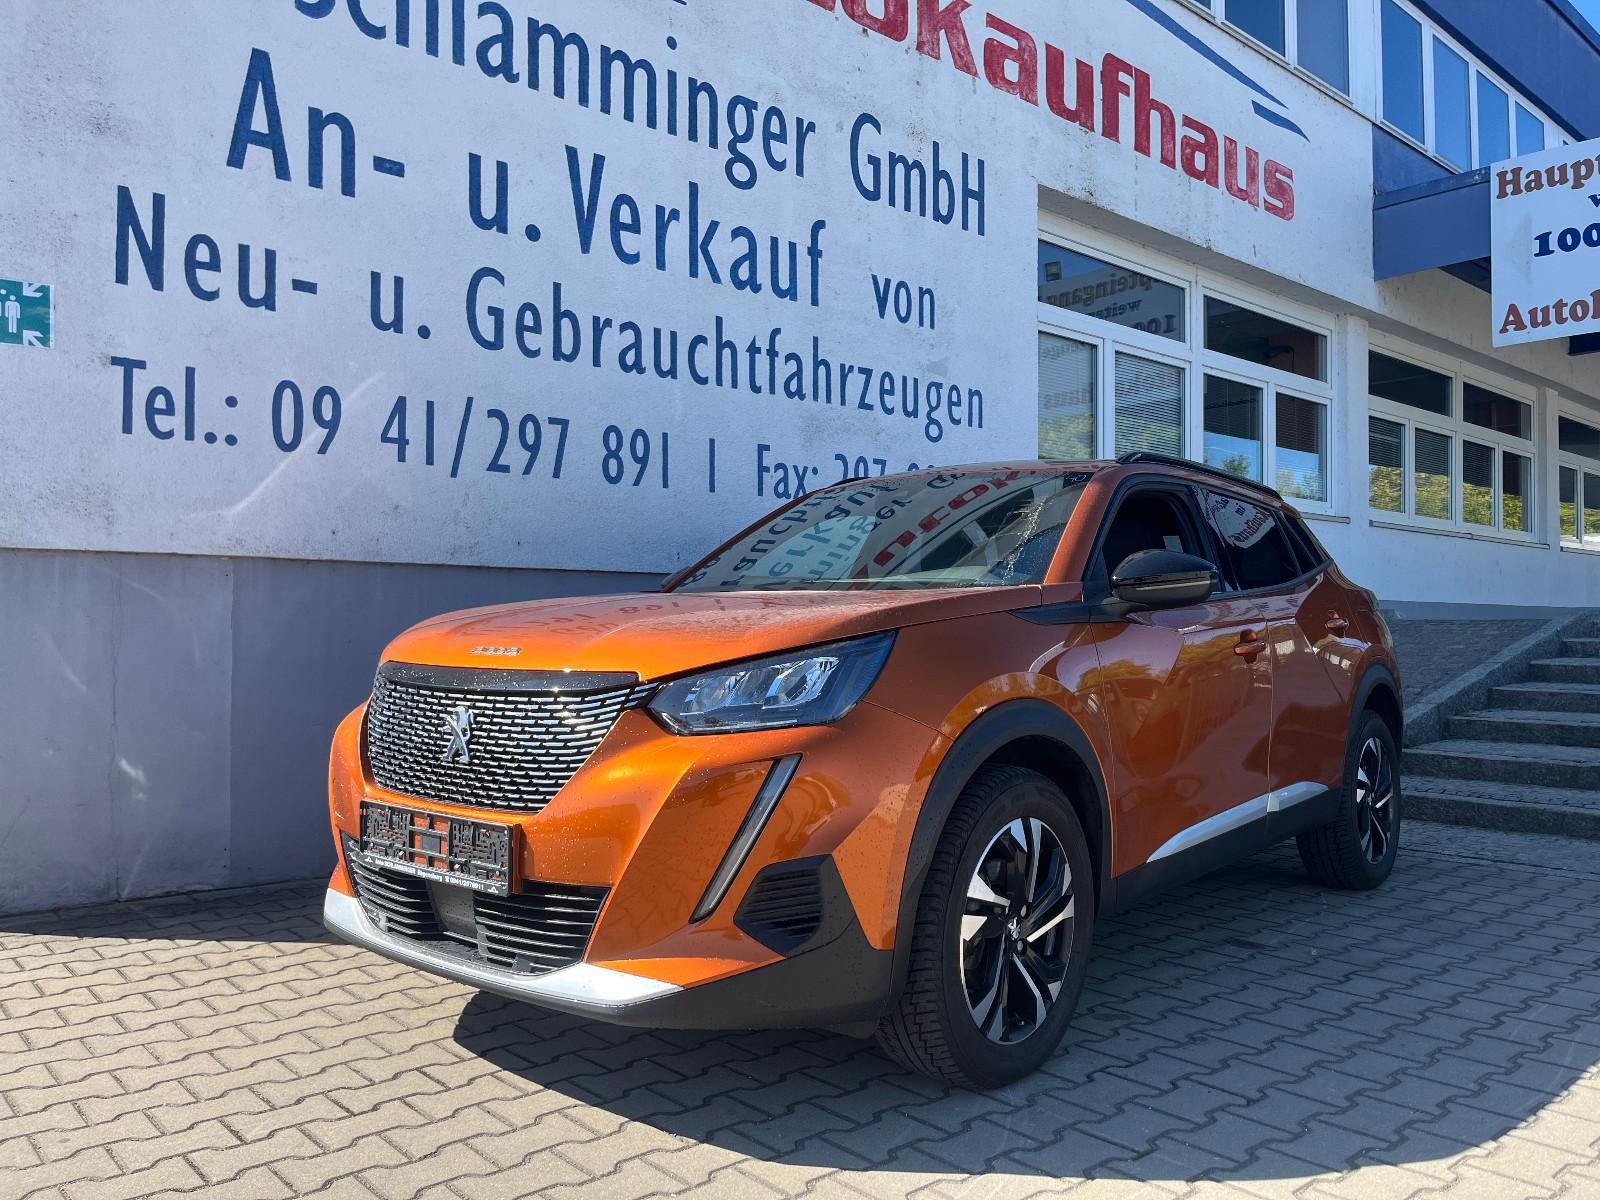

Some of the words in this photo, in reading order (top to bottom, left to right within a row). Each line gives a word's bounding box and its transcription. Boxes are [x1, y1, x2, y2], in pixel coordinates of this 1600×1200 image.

[226, 47, 406, 199] An-
[468, 151, 541, 243] u.
[564, 144, 827, 307] Verkauf
[870, 273, 936, 330] von
[294, 0, 816, 190] chlamminger
[849, 112, 986, 237] GmbH
[808, 0, 1296, 222] okaufhaus
[110, 355, 238, 446] Tel.:
[271, 379, 342, 455] 09
[380, 395, 570, 479] 41/297
[601, 425, 669, 489] 891
[114, 184, 318, 312] Neu-
[369, 269, 432, 341] u.
[465, 265, 985, 444] Gebrauchtfahrzeugen
